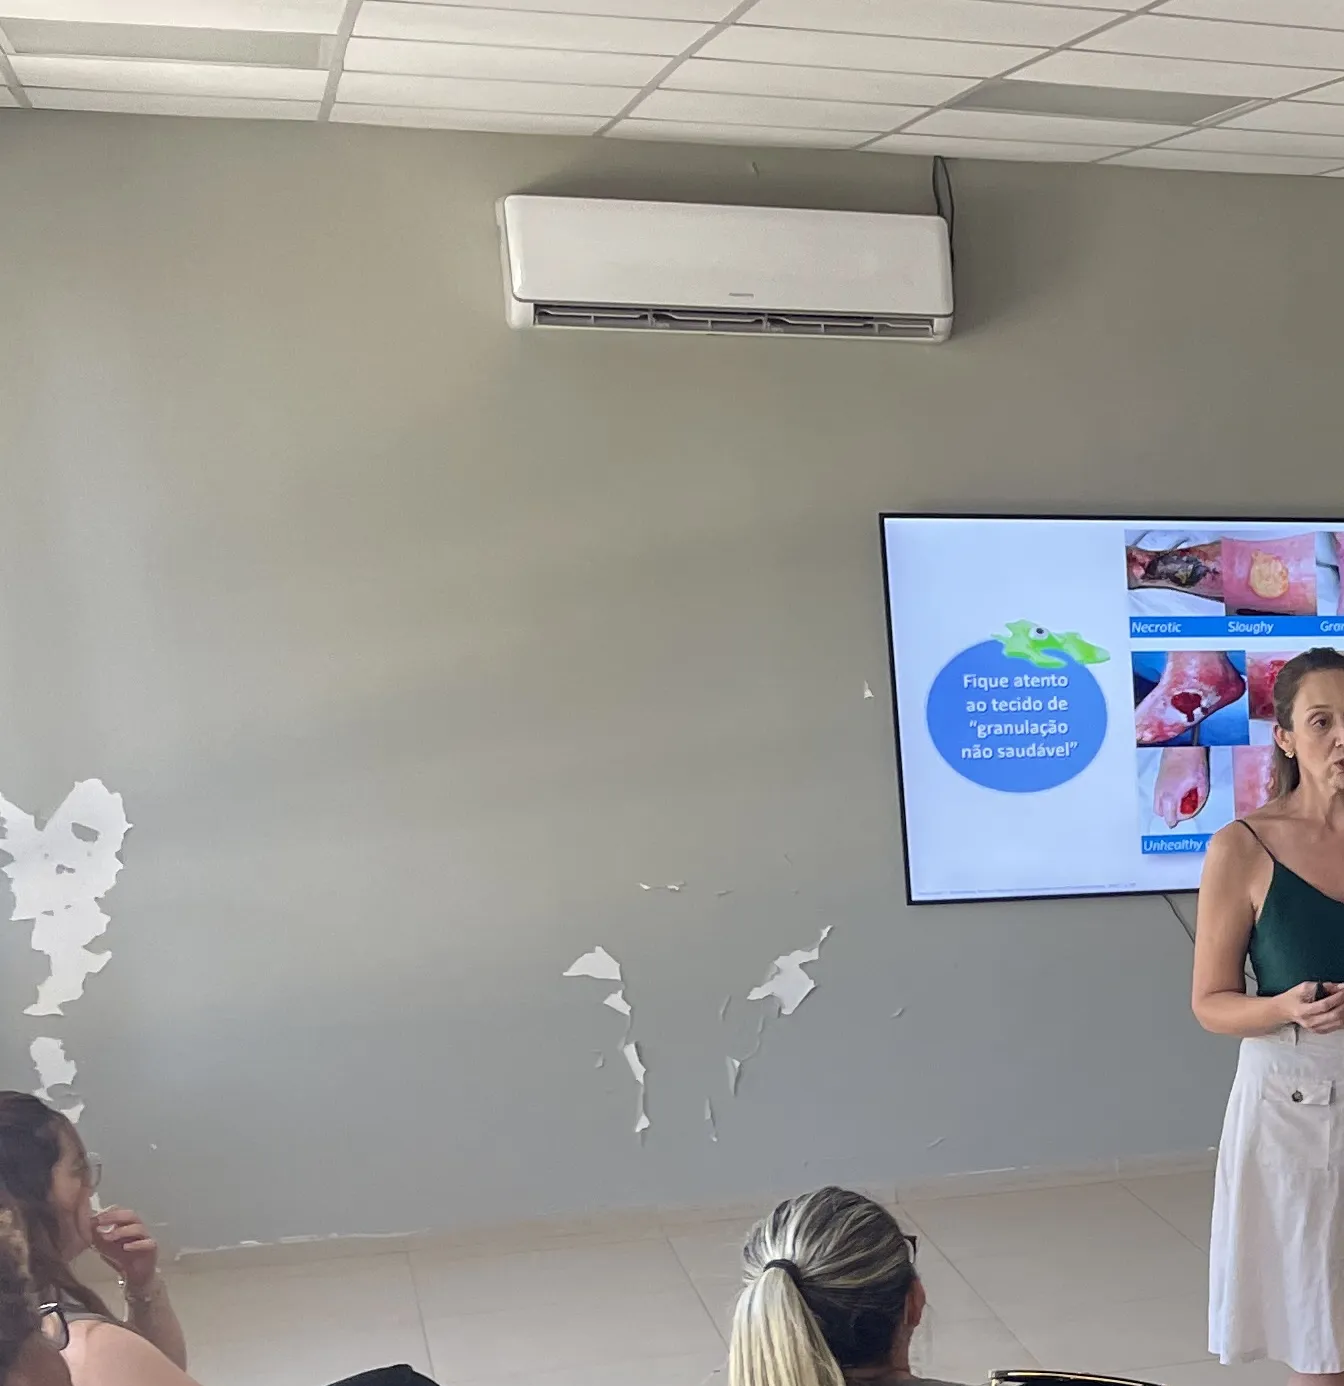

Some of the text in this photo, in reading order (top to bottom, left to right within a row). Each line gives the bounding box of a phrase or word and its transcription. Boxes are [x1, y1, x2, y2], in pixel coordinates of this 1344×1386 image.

[1131, 621, 1182, 633] Necrotic
[1227, 621, 1274, 635] Sloughy
[963, 674, 1069, 691] Fique atento
[966, 696, 1069, 712] ao tecido de
[961, 744, 993, 760] não
[1143, 838, 1203, 852] Unhealthy
